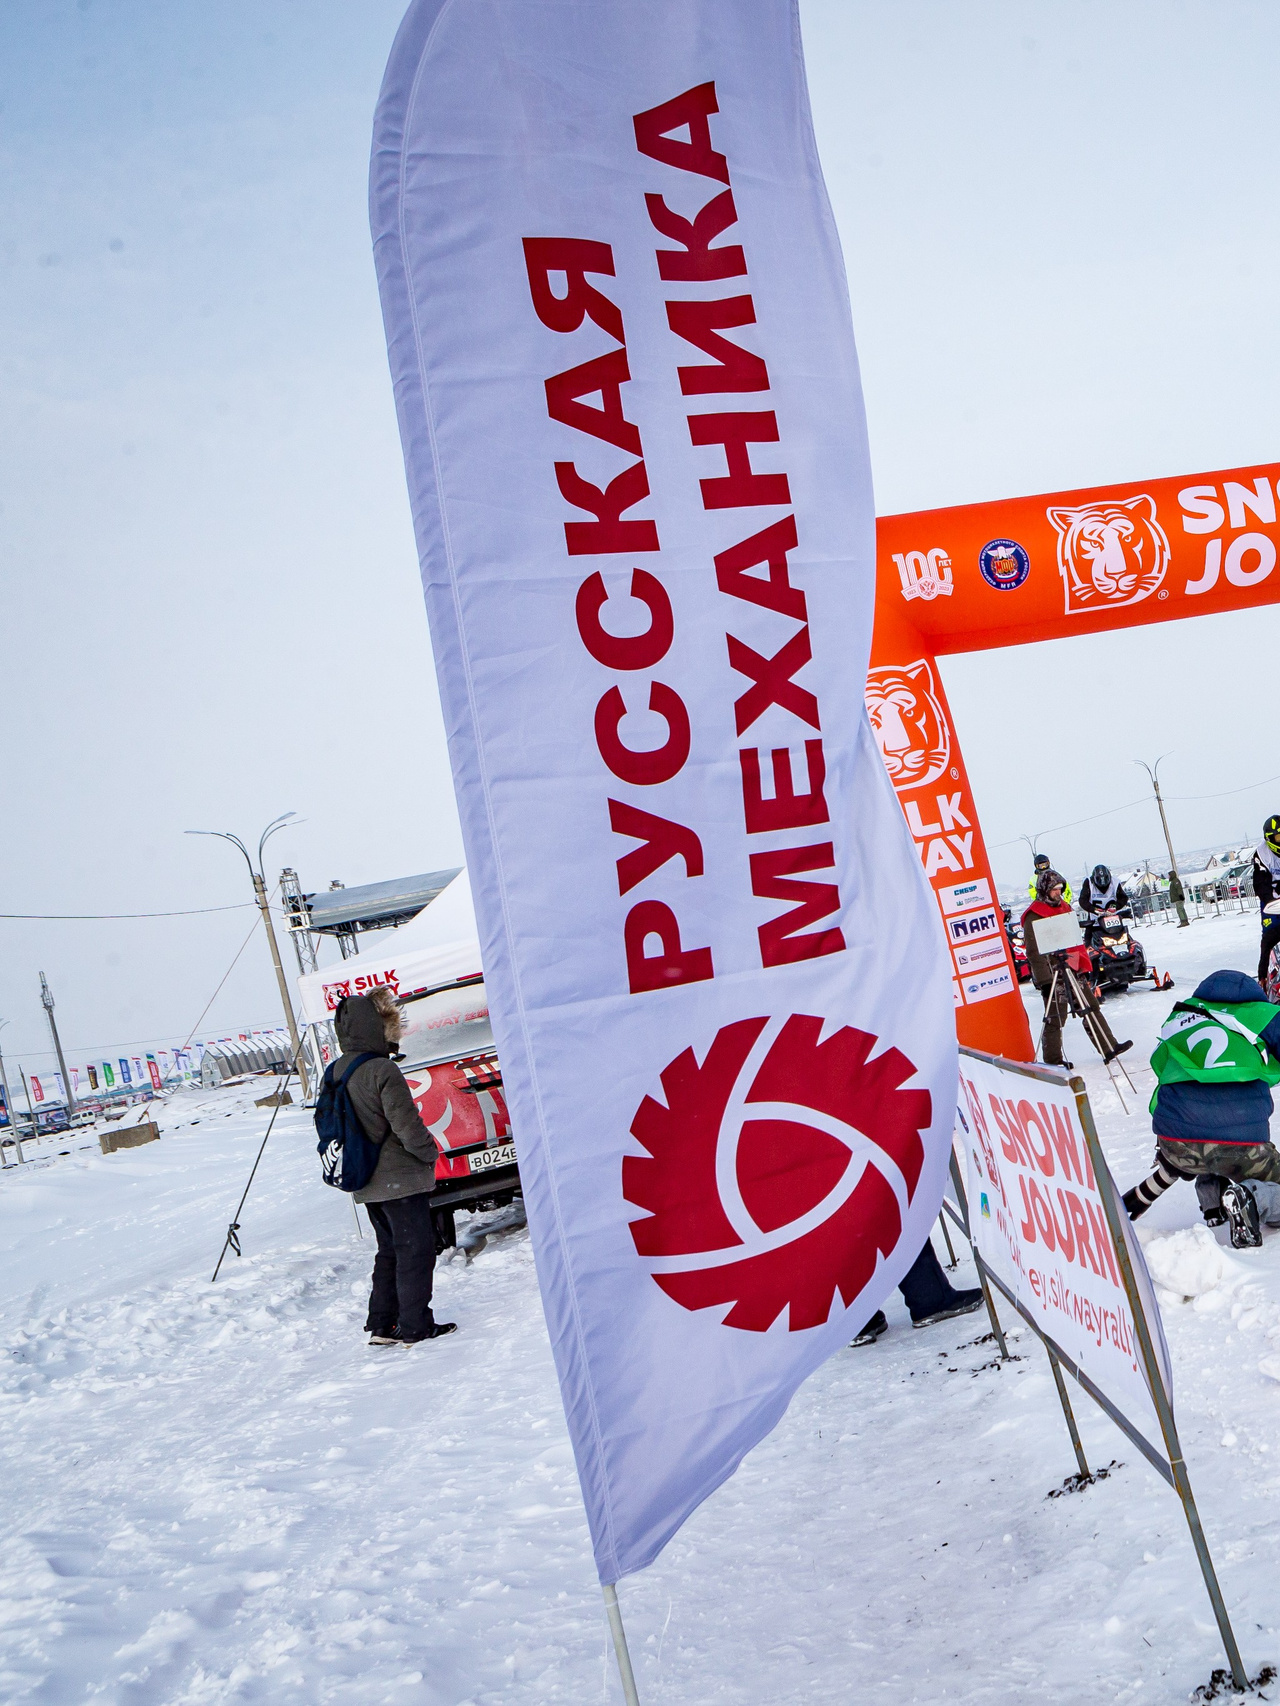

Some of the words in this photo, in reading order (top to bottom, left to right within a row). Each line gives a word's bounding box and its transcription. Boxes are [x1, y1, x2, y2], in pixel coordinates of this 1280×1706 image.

[632, 80, 846, 968] МЕХАНИКА
[522, 237, 714, 994] РУССКАЯ
[904, 792, 972, 837] LK
[953, 885, 977, 896] СИБУР
[951, 914, 996, 938] NART
[354, 969, 400, 991] SILK
[980, 974, 1009, 988] РУСАК
[1187, 1026, 1236, 1069] 2
[473, 1147, 517, 1168] В024Е
[988, 1092, 1084, 1186] SNOW
[1019, 1174, 1126, 1289] JOURN
